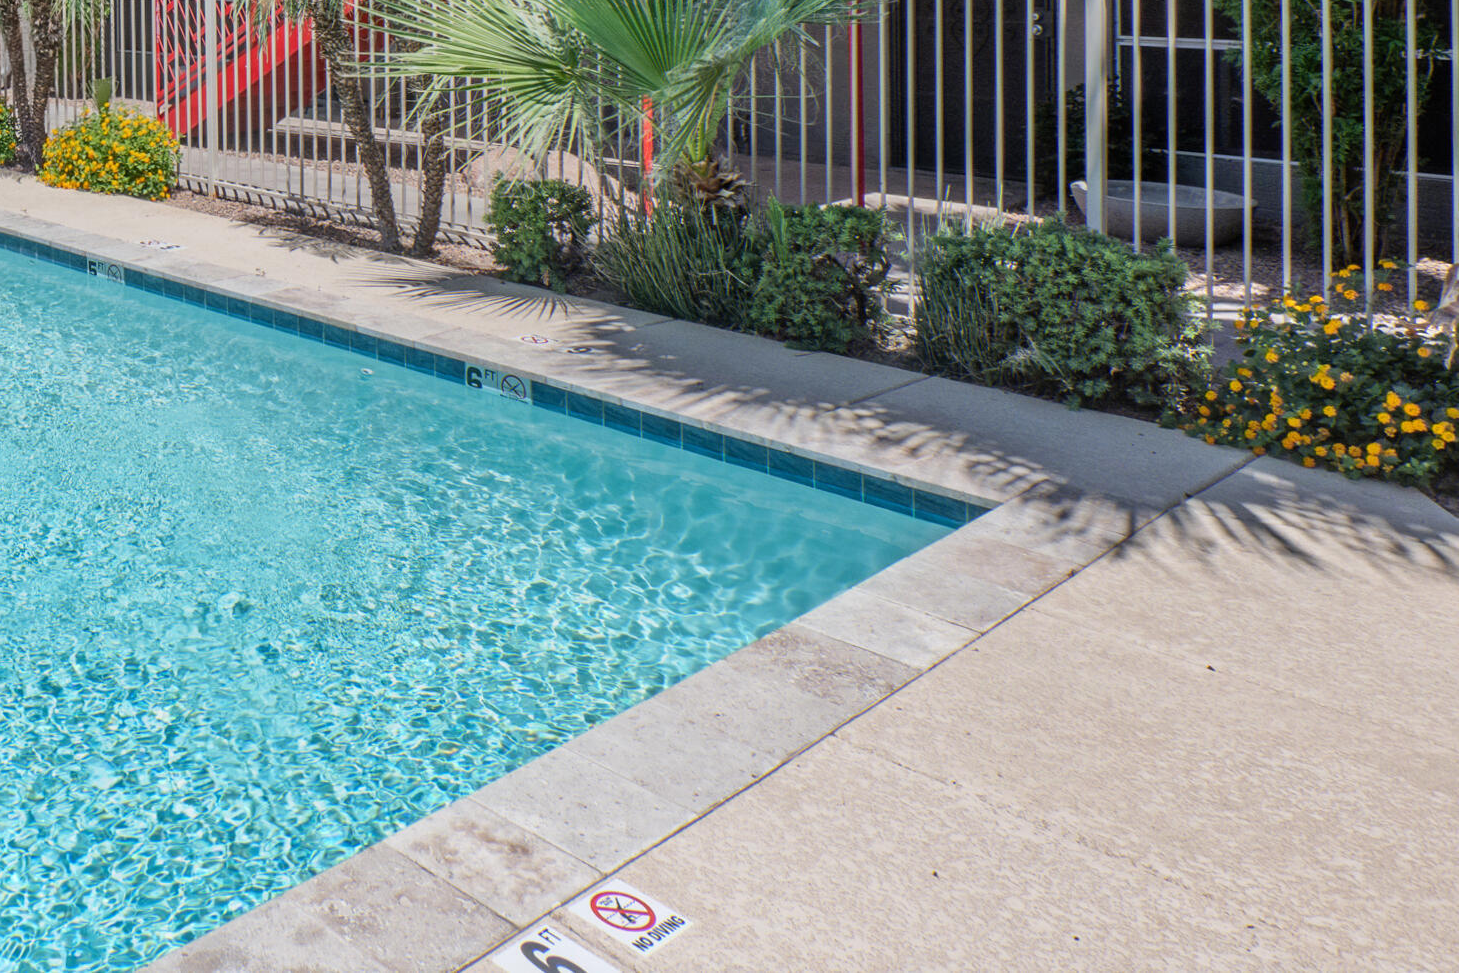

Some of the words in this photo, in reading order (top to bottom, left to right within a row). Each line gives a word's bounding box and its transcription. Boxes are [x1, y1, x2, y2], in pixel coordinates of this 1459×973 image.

[88, 260, 98, 276] 5
[466, 366, 483, 389] 6
[484, 368, 496, 381] FT
[538, 927, 562, 946] FT
[631, 937, 654, 952] NO
[646, 915, 686, 942] DIVING
